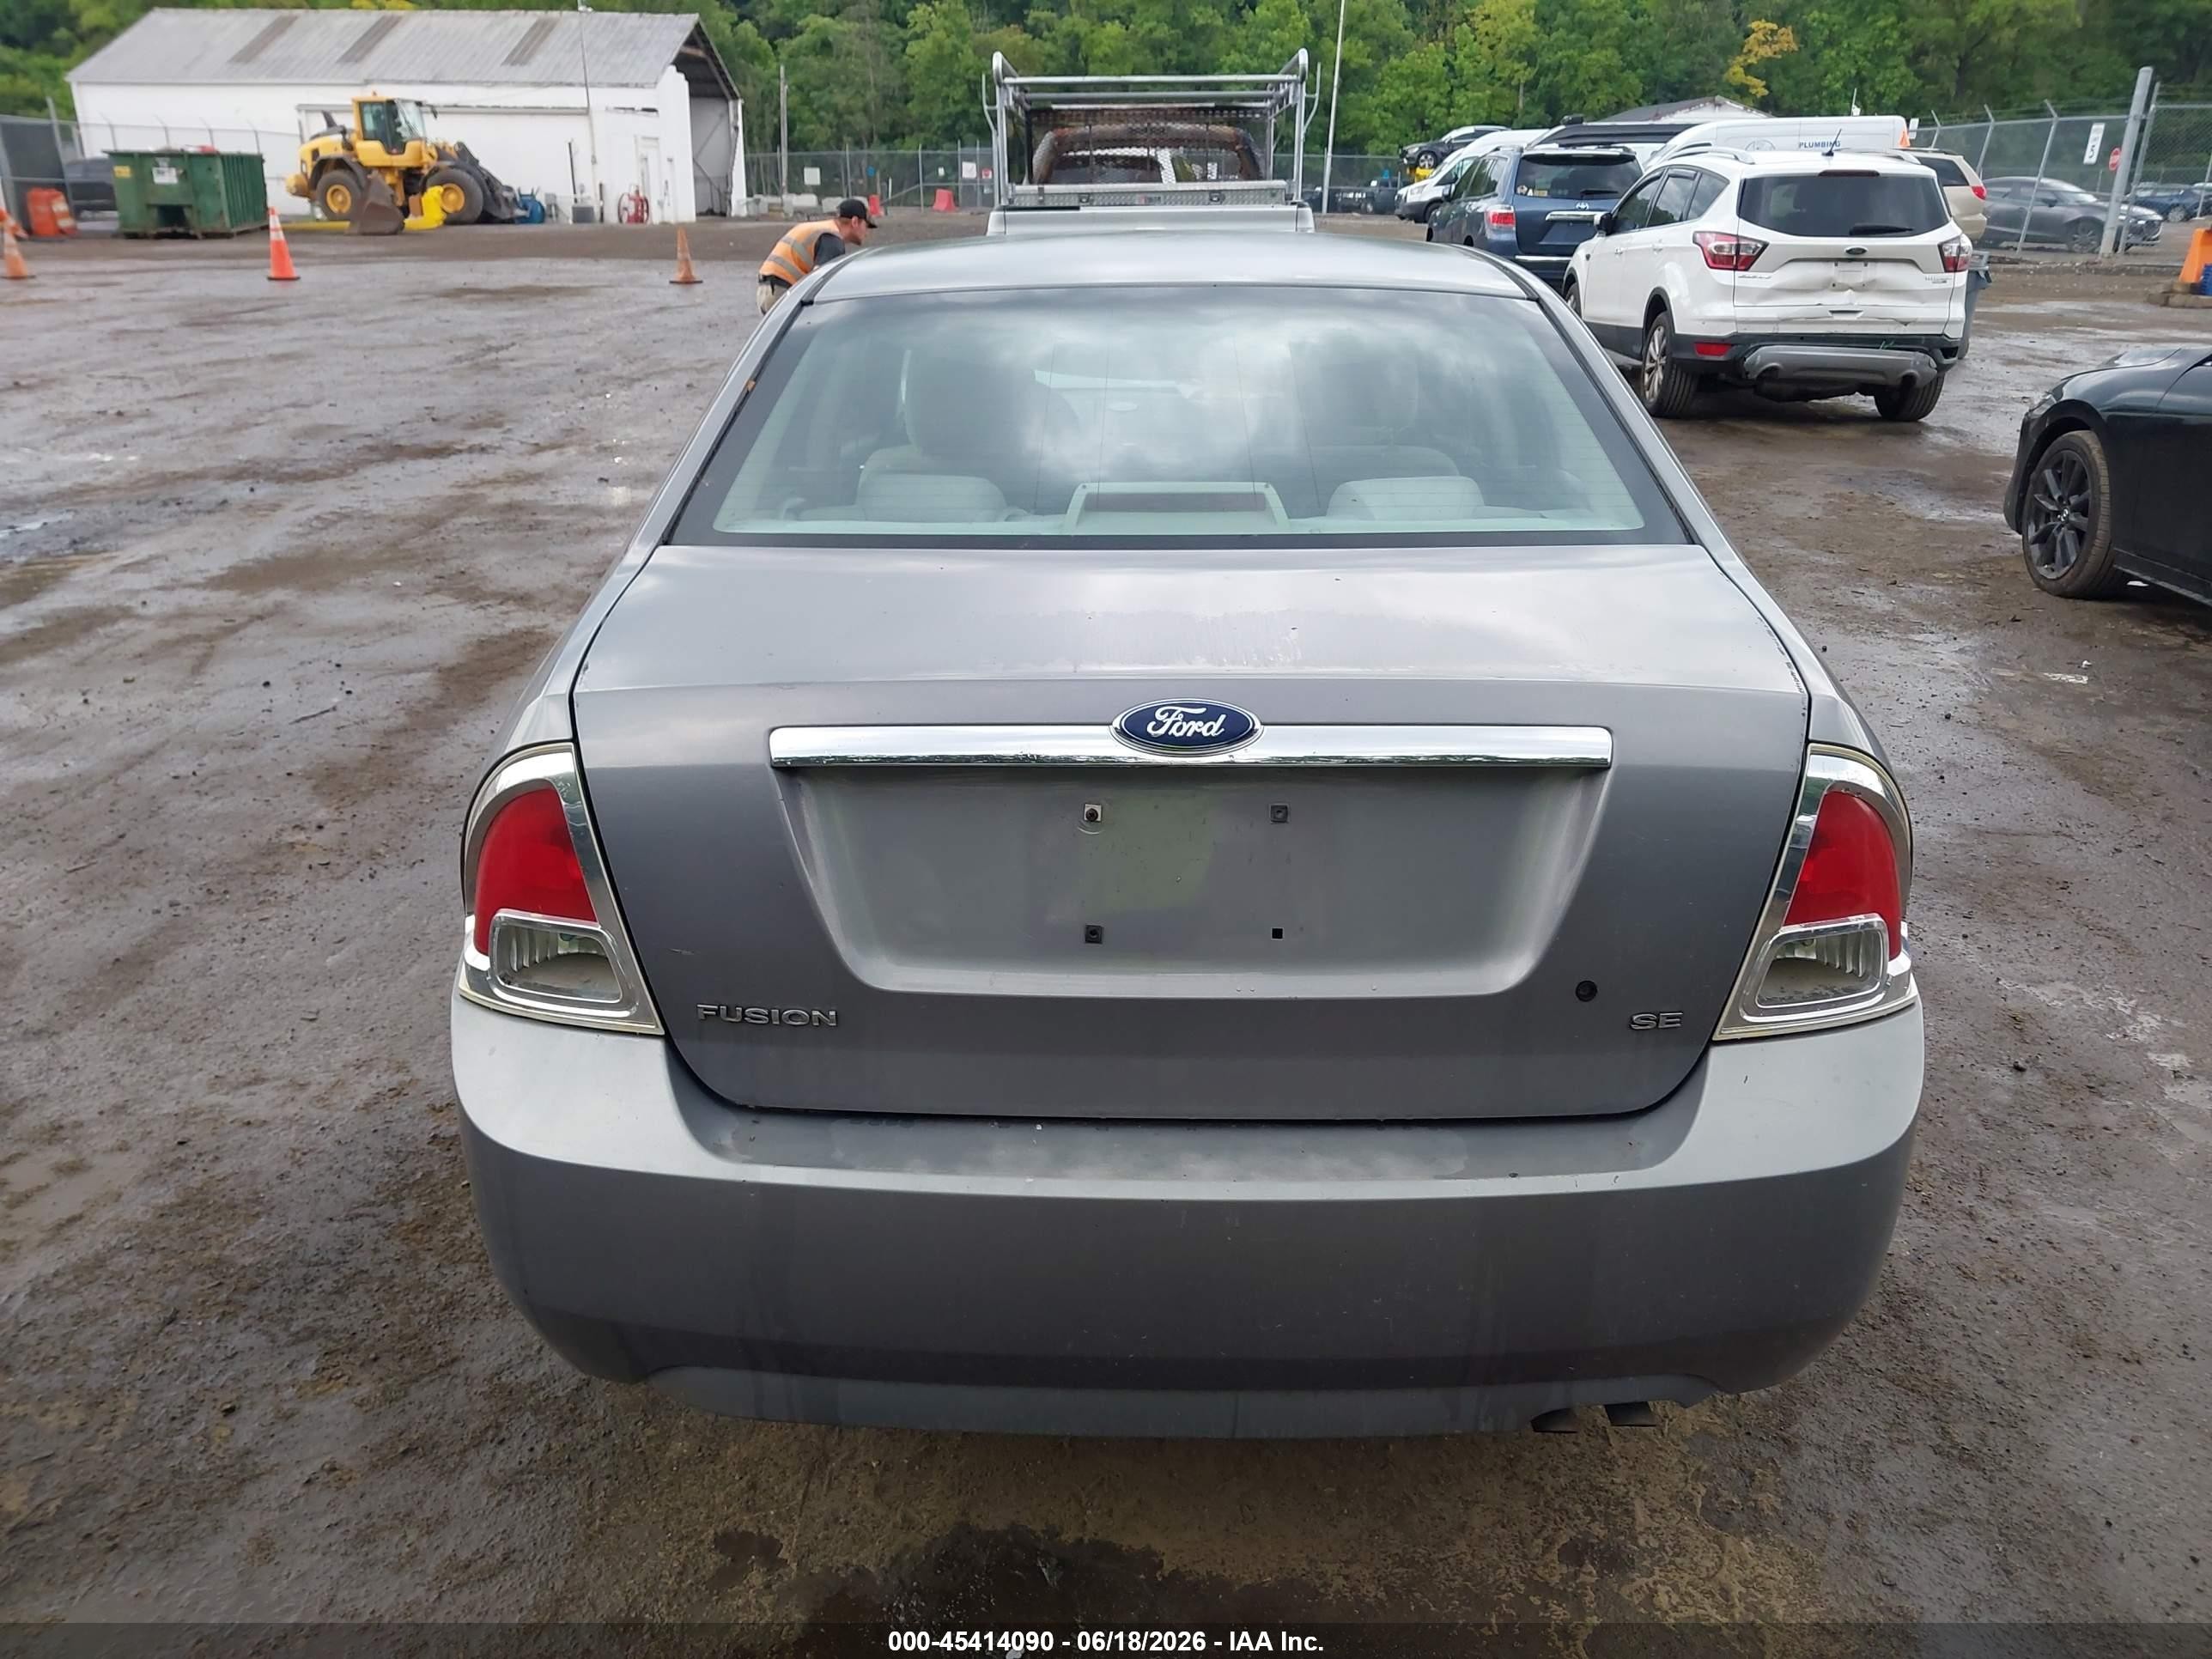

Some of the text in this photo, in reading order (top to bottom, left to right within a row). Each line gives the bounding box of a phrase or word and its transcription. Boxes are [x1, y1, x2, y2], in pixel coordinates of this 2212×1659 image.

[1146, 706, 1227, 738] Ford
[696, 1004, 837, 1027] FUSION
[1631, 1012, 1684, 1030] SE
